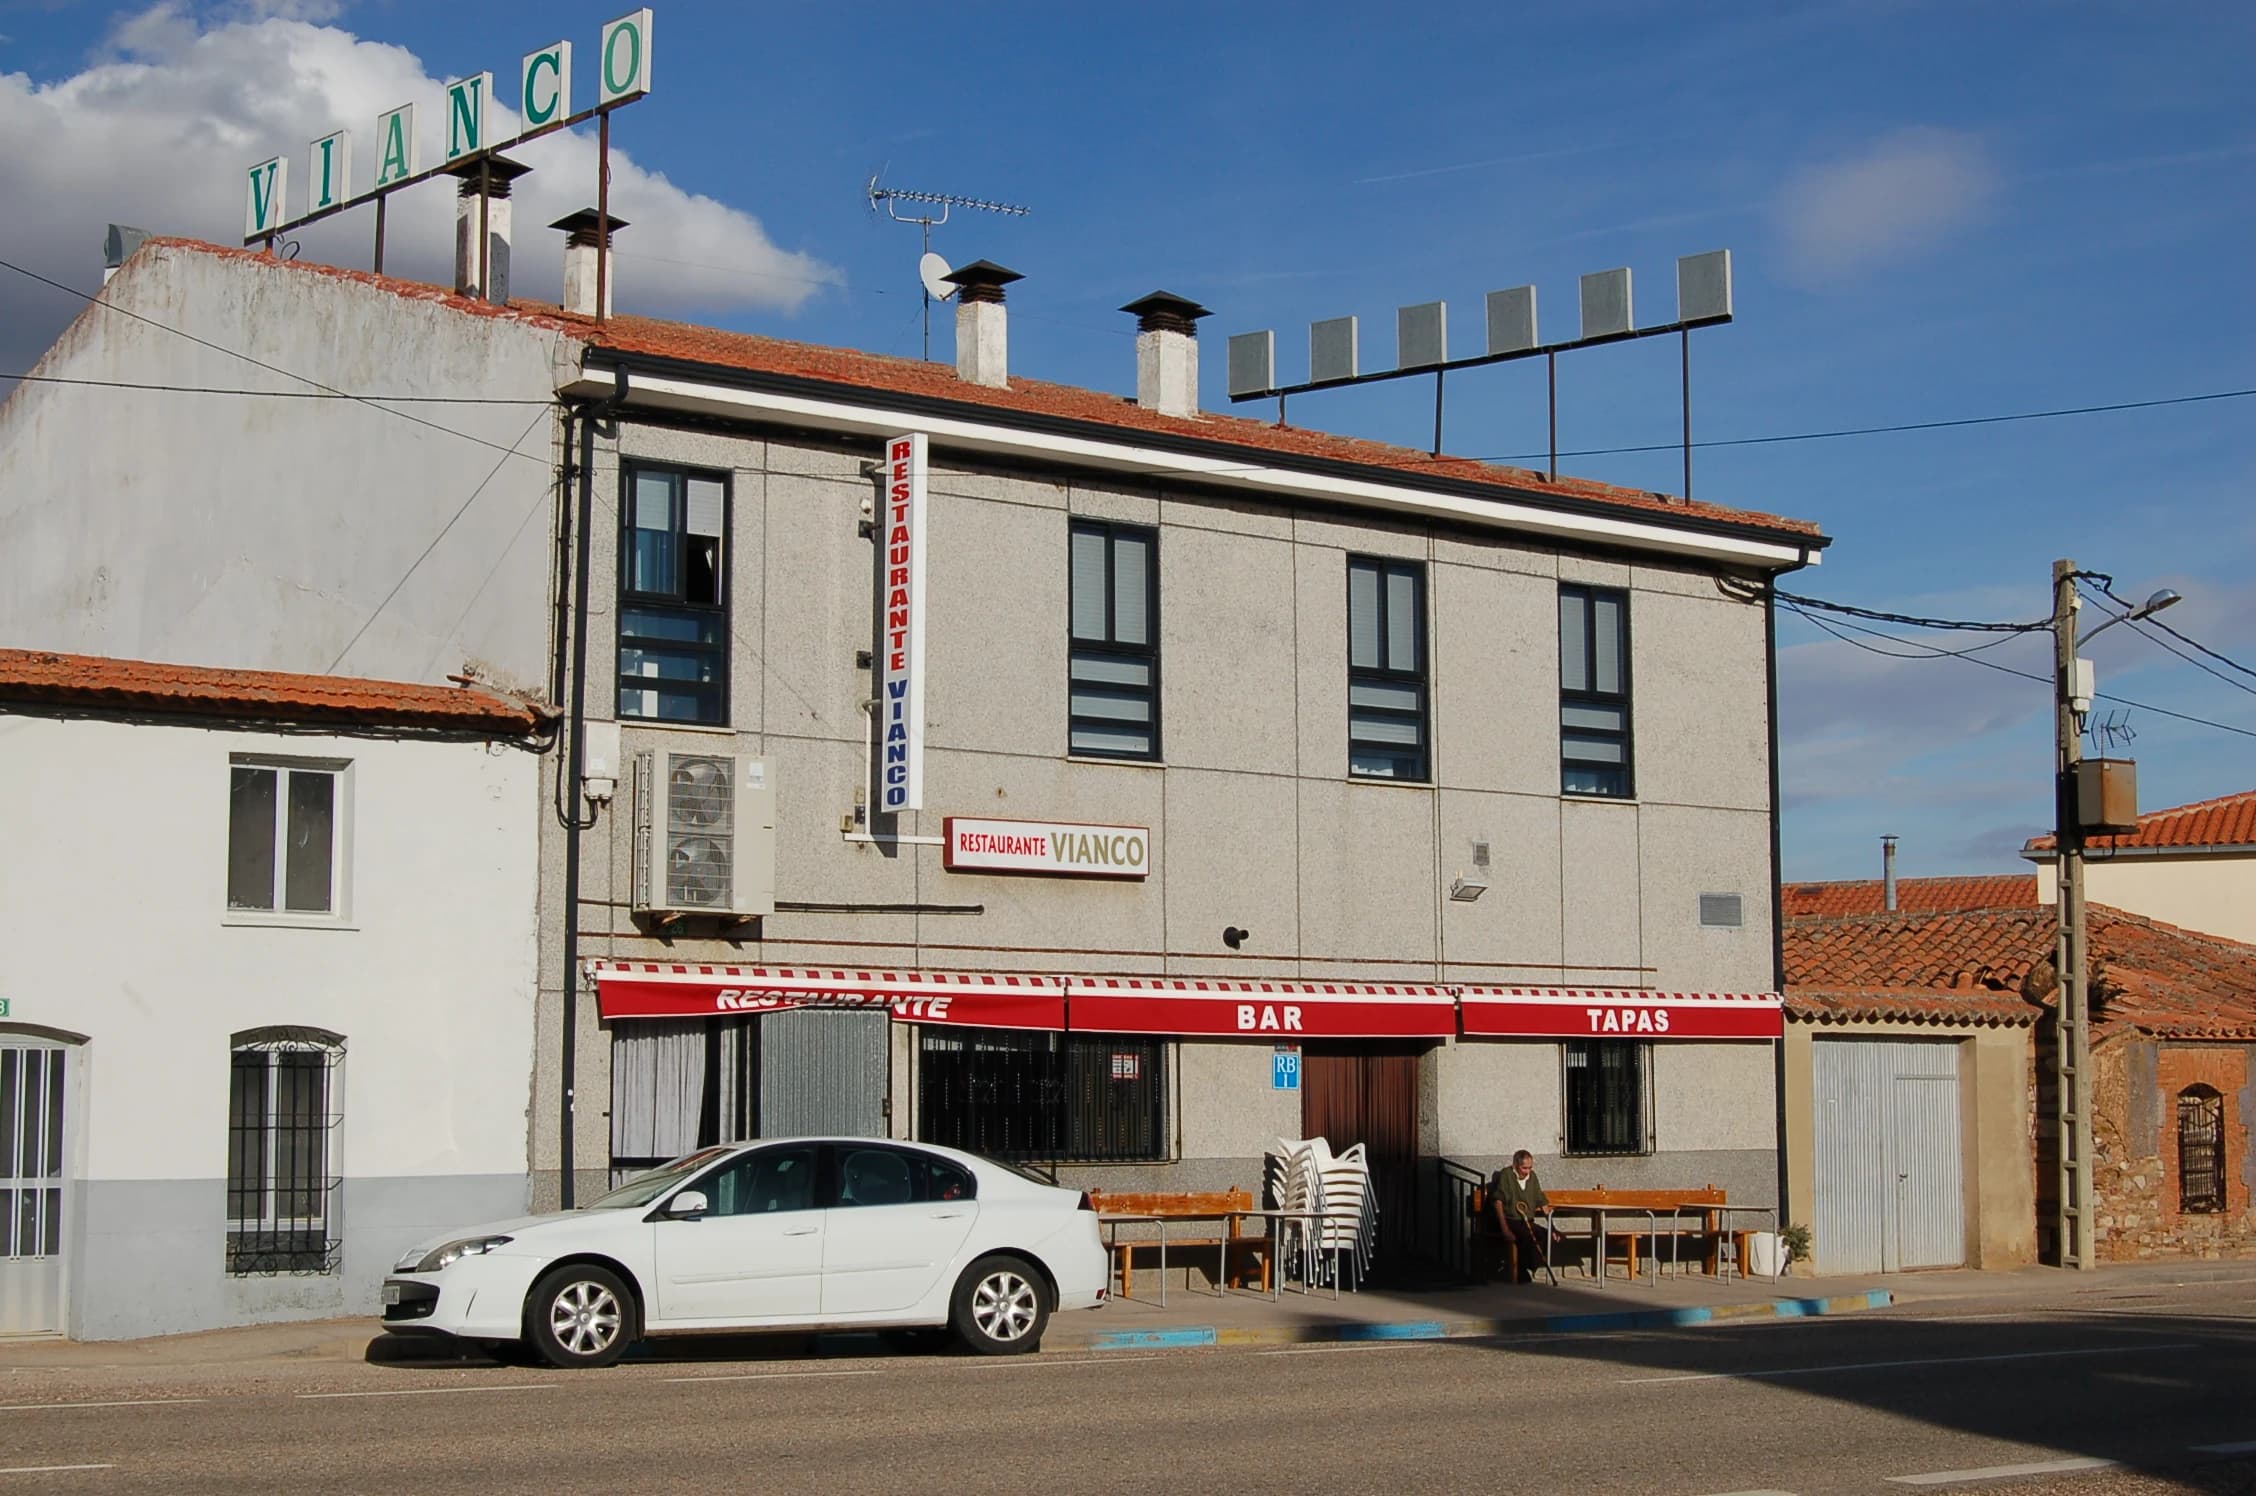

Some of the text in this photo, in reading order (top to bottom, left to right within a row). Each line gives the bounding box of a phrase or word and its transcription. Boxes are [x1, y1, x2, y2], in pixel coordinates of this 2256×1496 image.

[250, 22, 640, 230] VIANCO
[887, 441, 911, 806] RESTAURANTE VIANCO
[960, 832, 1144, 866] RESTAURANTE VIANCO
[1237, 1004, 1303, 1031] BAR
[1587, 1008, 1669, 1032] TAPAS
[1277, 1056, 1296, 1073] RB
